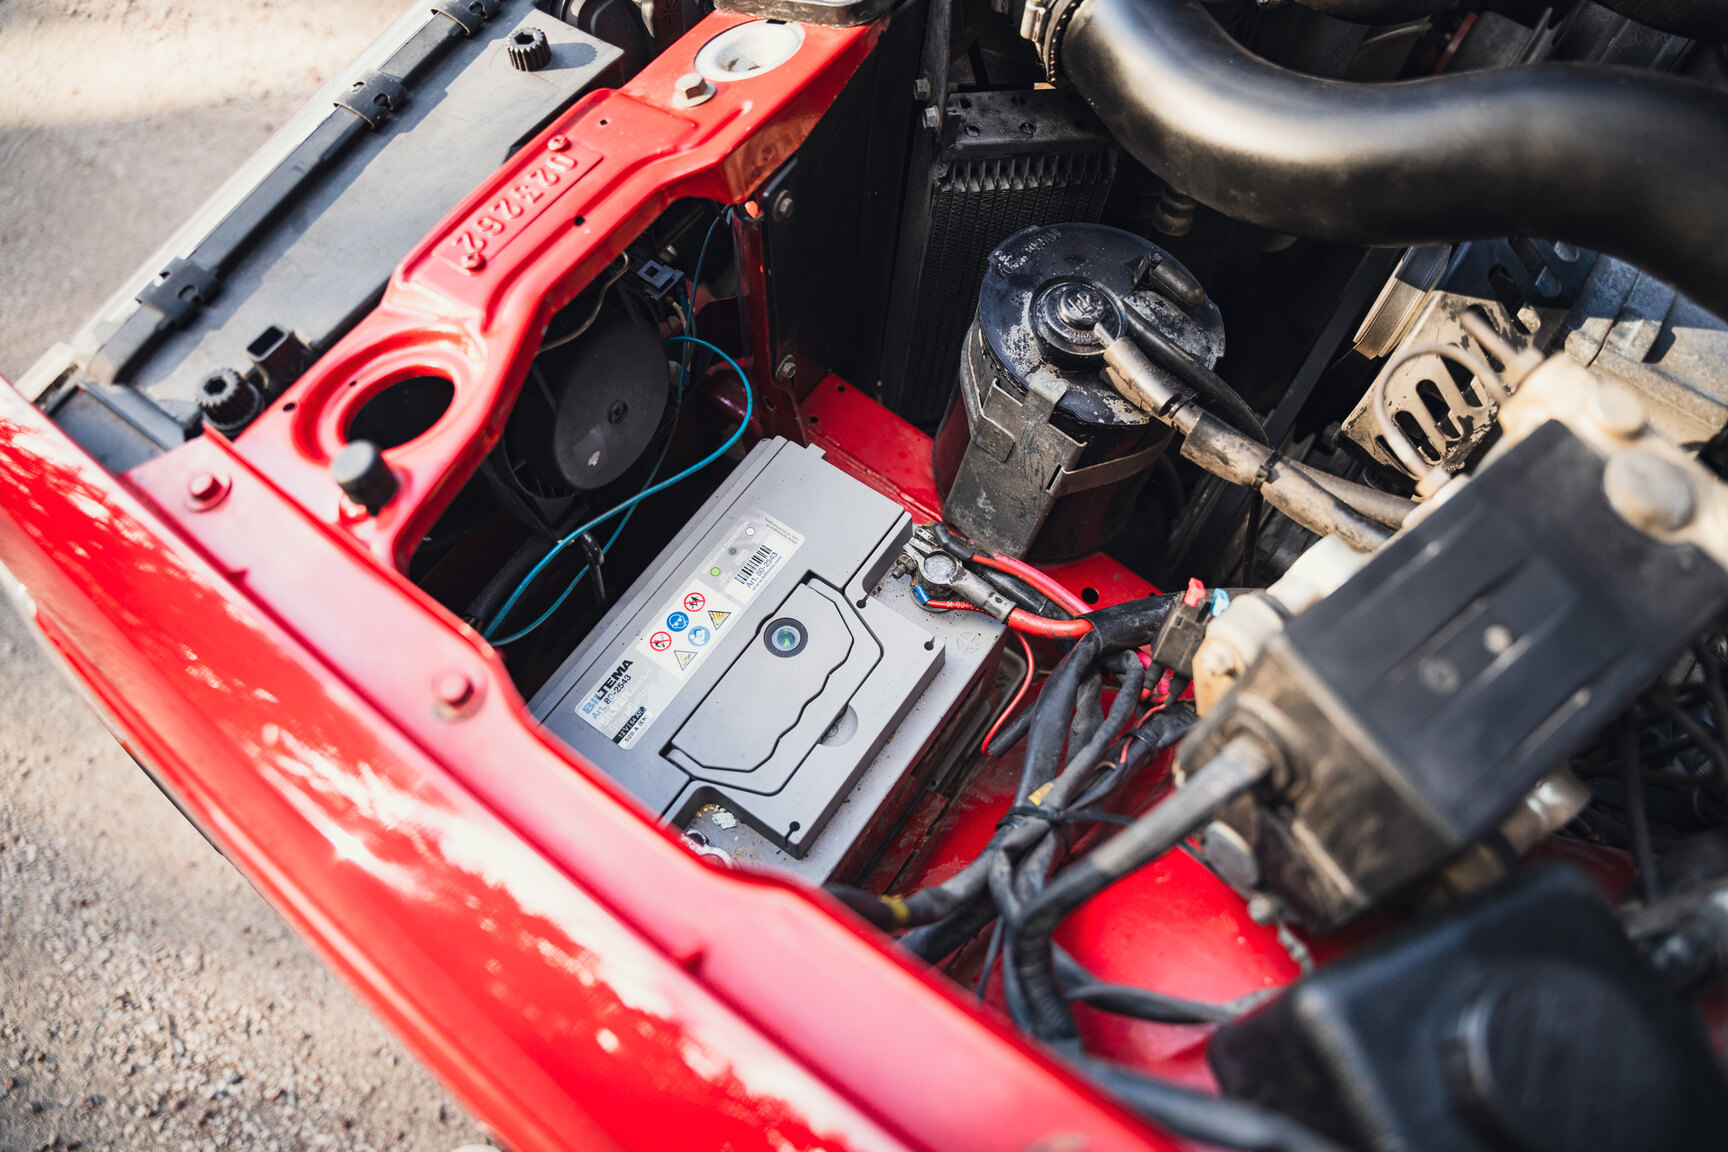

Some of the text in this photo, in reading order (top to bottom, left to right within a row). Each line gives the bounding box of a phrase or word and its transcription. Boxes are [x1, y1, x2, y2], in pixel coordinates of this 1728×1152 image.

[746, 574, 758, 588] Art.
[755, 551, 778, 576] 80-2543
[582, 659, 633, 715] BILTEMA
[591, 703, 606, 719] Art.
[603, 674, 632, 705] 80-2543
